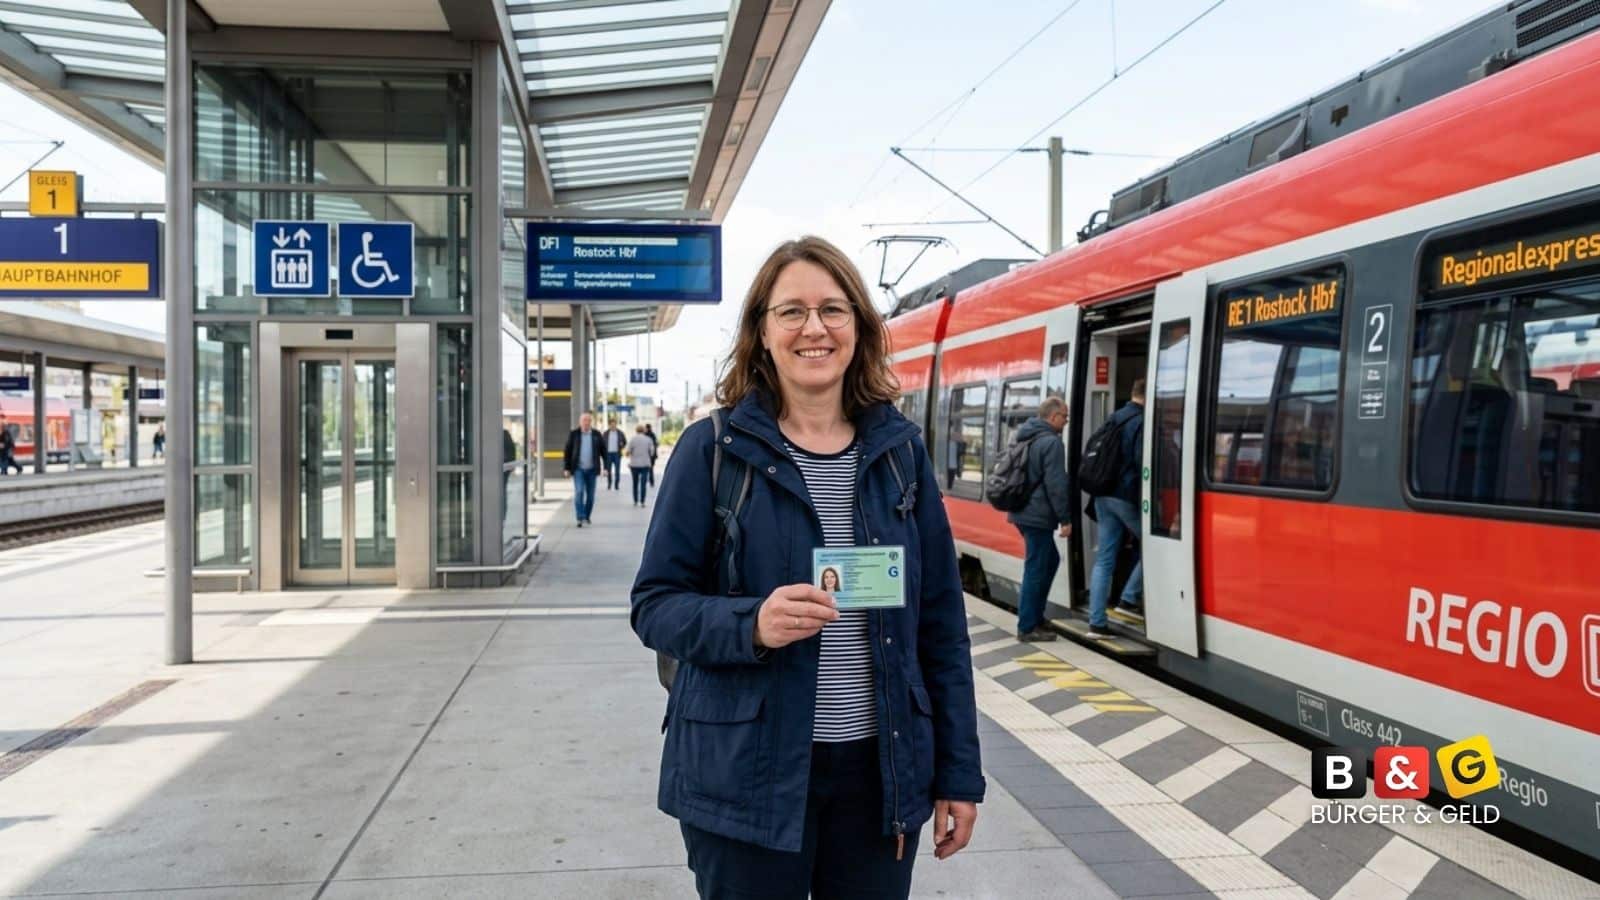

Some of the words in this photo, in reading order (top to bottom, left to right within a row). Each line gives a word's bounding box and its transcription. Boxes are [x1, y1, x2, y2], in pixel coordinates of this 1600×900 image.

[36, 175, 67, 186] GLEIS
[47, 189, 57, 209] 1
[53, 223, 68, 255] 1
[619, 247, 637, 258] Hbf
[1441, 232, 1600, 286] Regionalexpres
[0, 268, 122, 284] AUPTBAHNHOF
[1227, 298, 1252, 327] RE1
[1255, 288, 1308, 322] Rostock
[1310, 281, 1338, 312] Hbf
[1368, 311, 1385, 353] 2
[888, 565, 899, 578] G
[1406, 587, 1568, 679] REGIO
[1341, 708, 1374, 738] Class
[1377, 722, 1402, 747] 442
